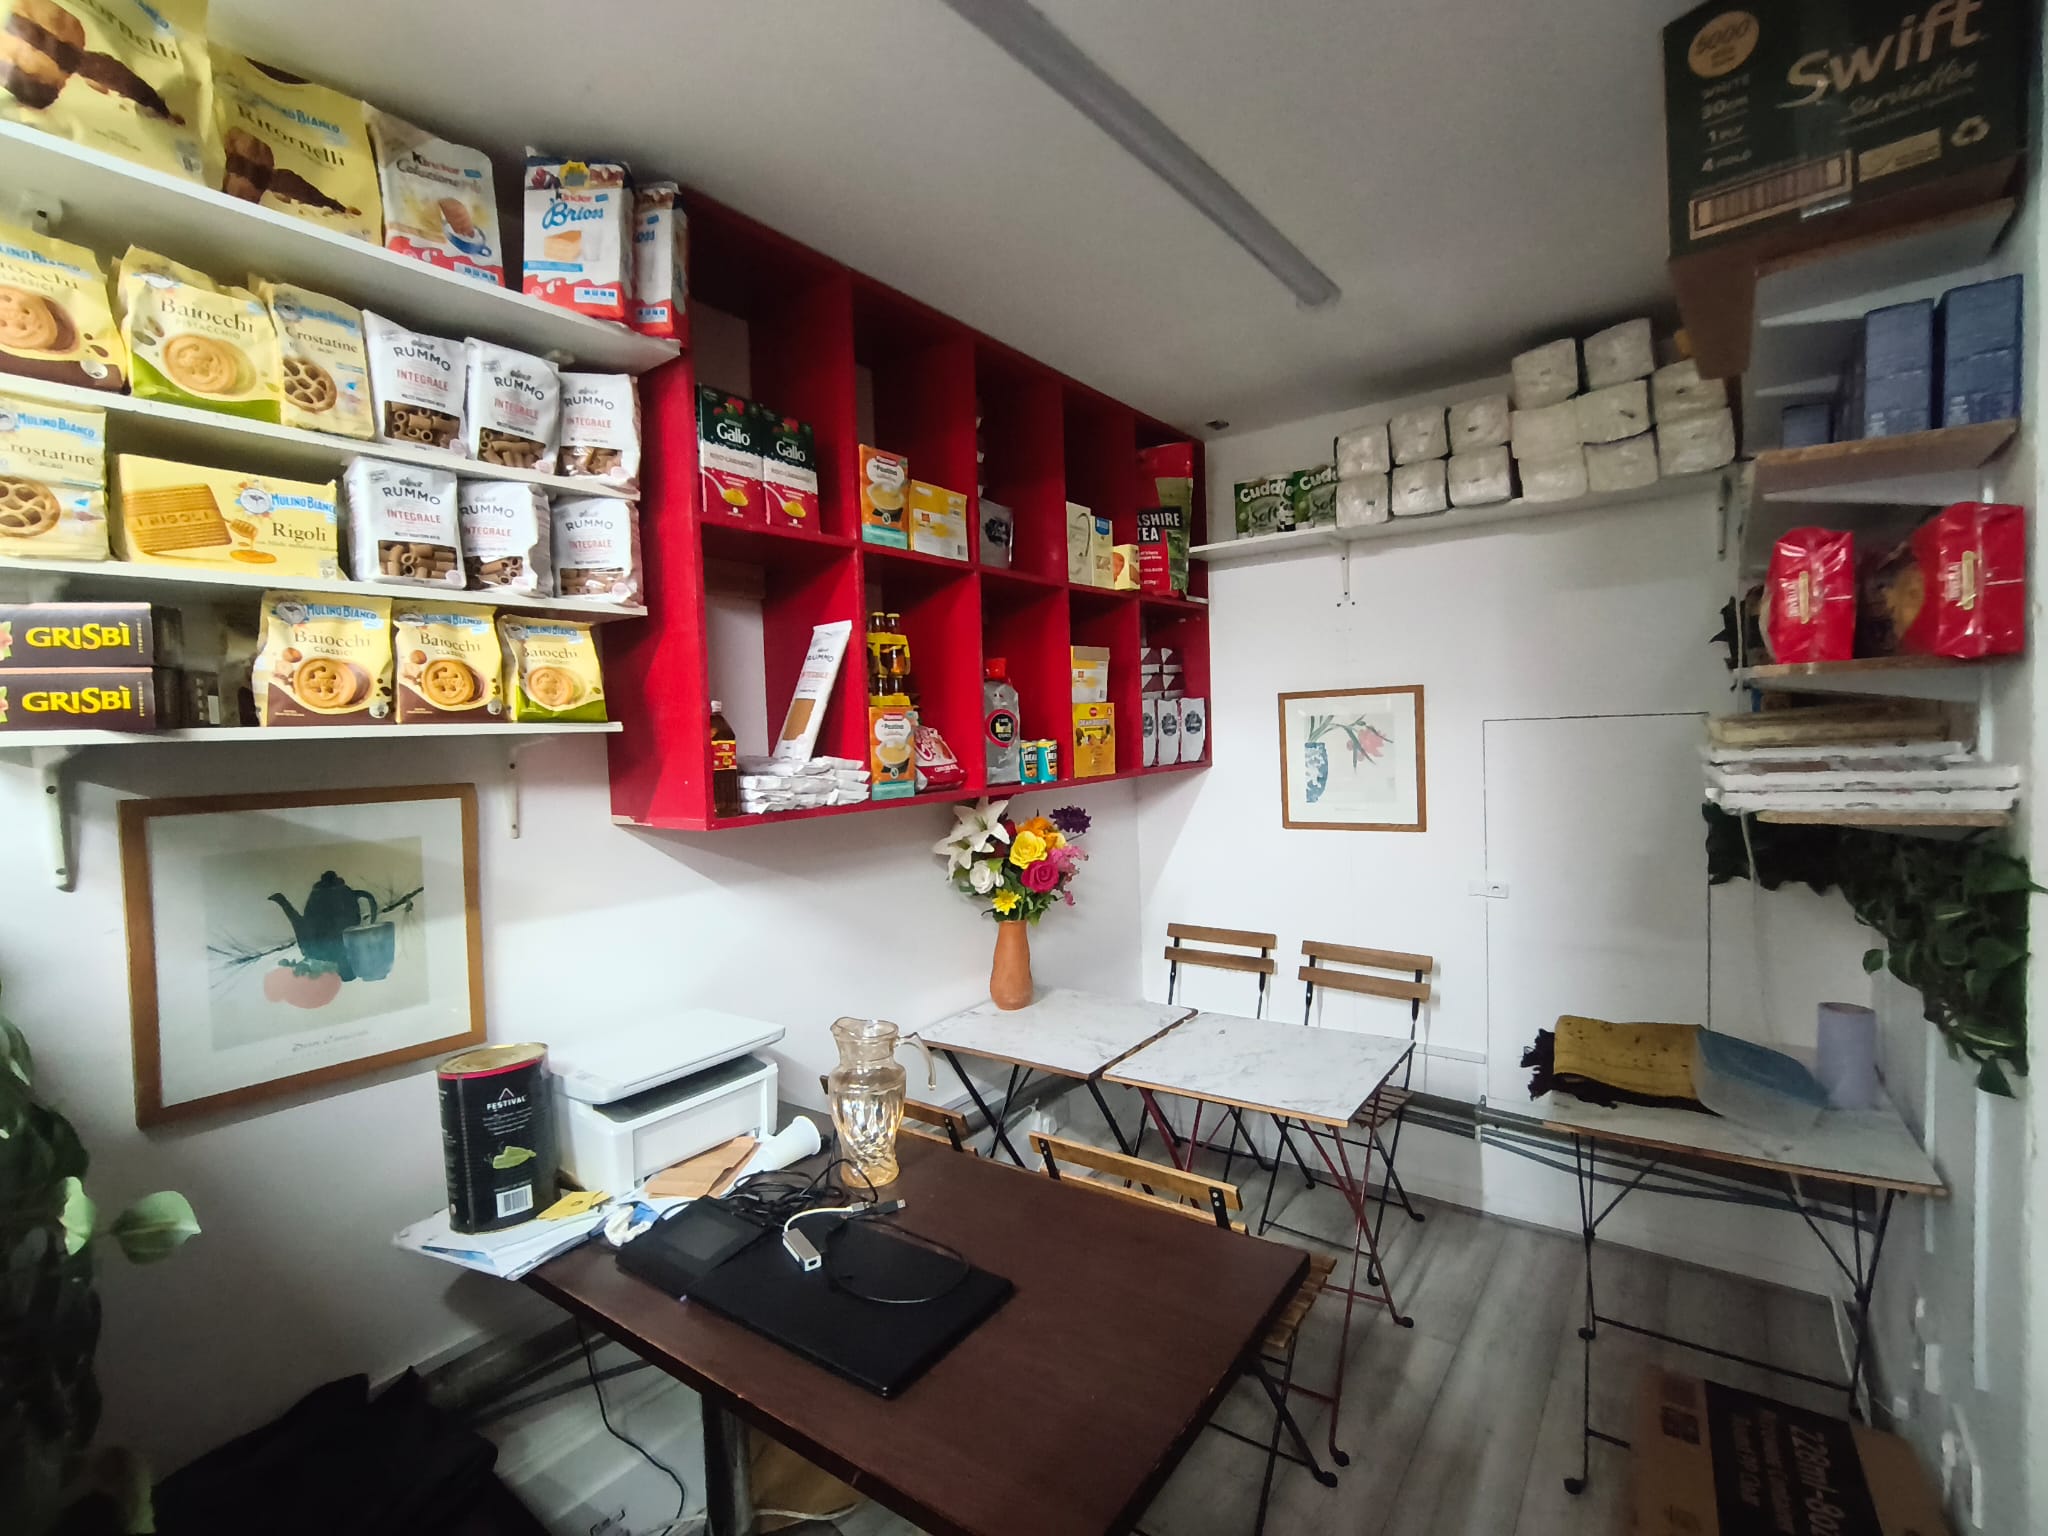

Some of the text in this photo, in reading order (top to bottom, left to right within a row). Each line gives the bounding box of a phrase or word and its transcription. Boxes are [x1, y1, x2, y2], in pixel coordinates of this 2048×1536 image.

[1776, 0, 1990, 109] Swift
[237, 103, 346, 166] Ritornelli
[541, 198, 605, 231] Brioss
[161, 297, 255, 334] Baiocchi
[285, 325, 358, 353] Crostatine
[394, 346, 451, 372] RUMMO
[396, 368, 449, 393] INTEGRALE
[494, 376, 545, 401] RUMMO
[564, 395, 615, 411] RUMMO
[58, 417, 96, 438] BIANCO
[716, 422, 751, 446] Gallo
[10, 443, 96, 467] rostatine
[775, 440, 806, 463] Gallo
[272, 493, 306, 508] MULINO
[383, 486, 441, 505] RUMMO
[386, 509, 441, 524] INTEGRALE
[566, 519, 613, 531] RUMMO
[272, 521, 327, 542] Rigoli
[306, 603, 377, 620] MULINO BIANCO
[25, 621, 131, 650] GRISBÌ
[294, 630, 371, 649] Baiocchi
[421, 632, 480, 652] Baiocchi
[21, 685, 132, 714] GRISBÌ
[486, 1095, 526, 1111] FESTIVAL
